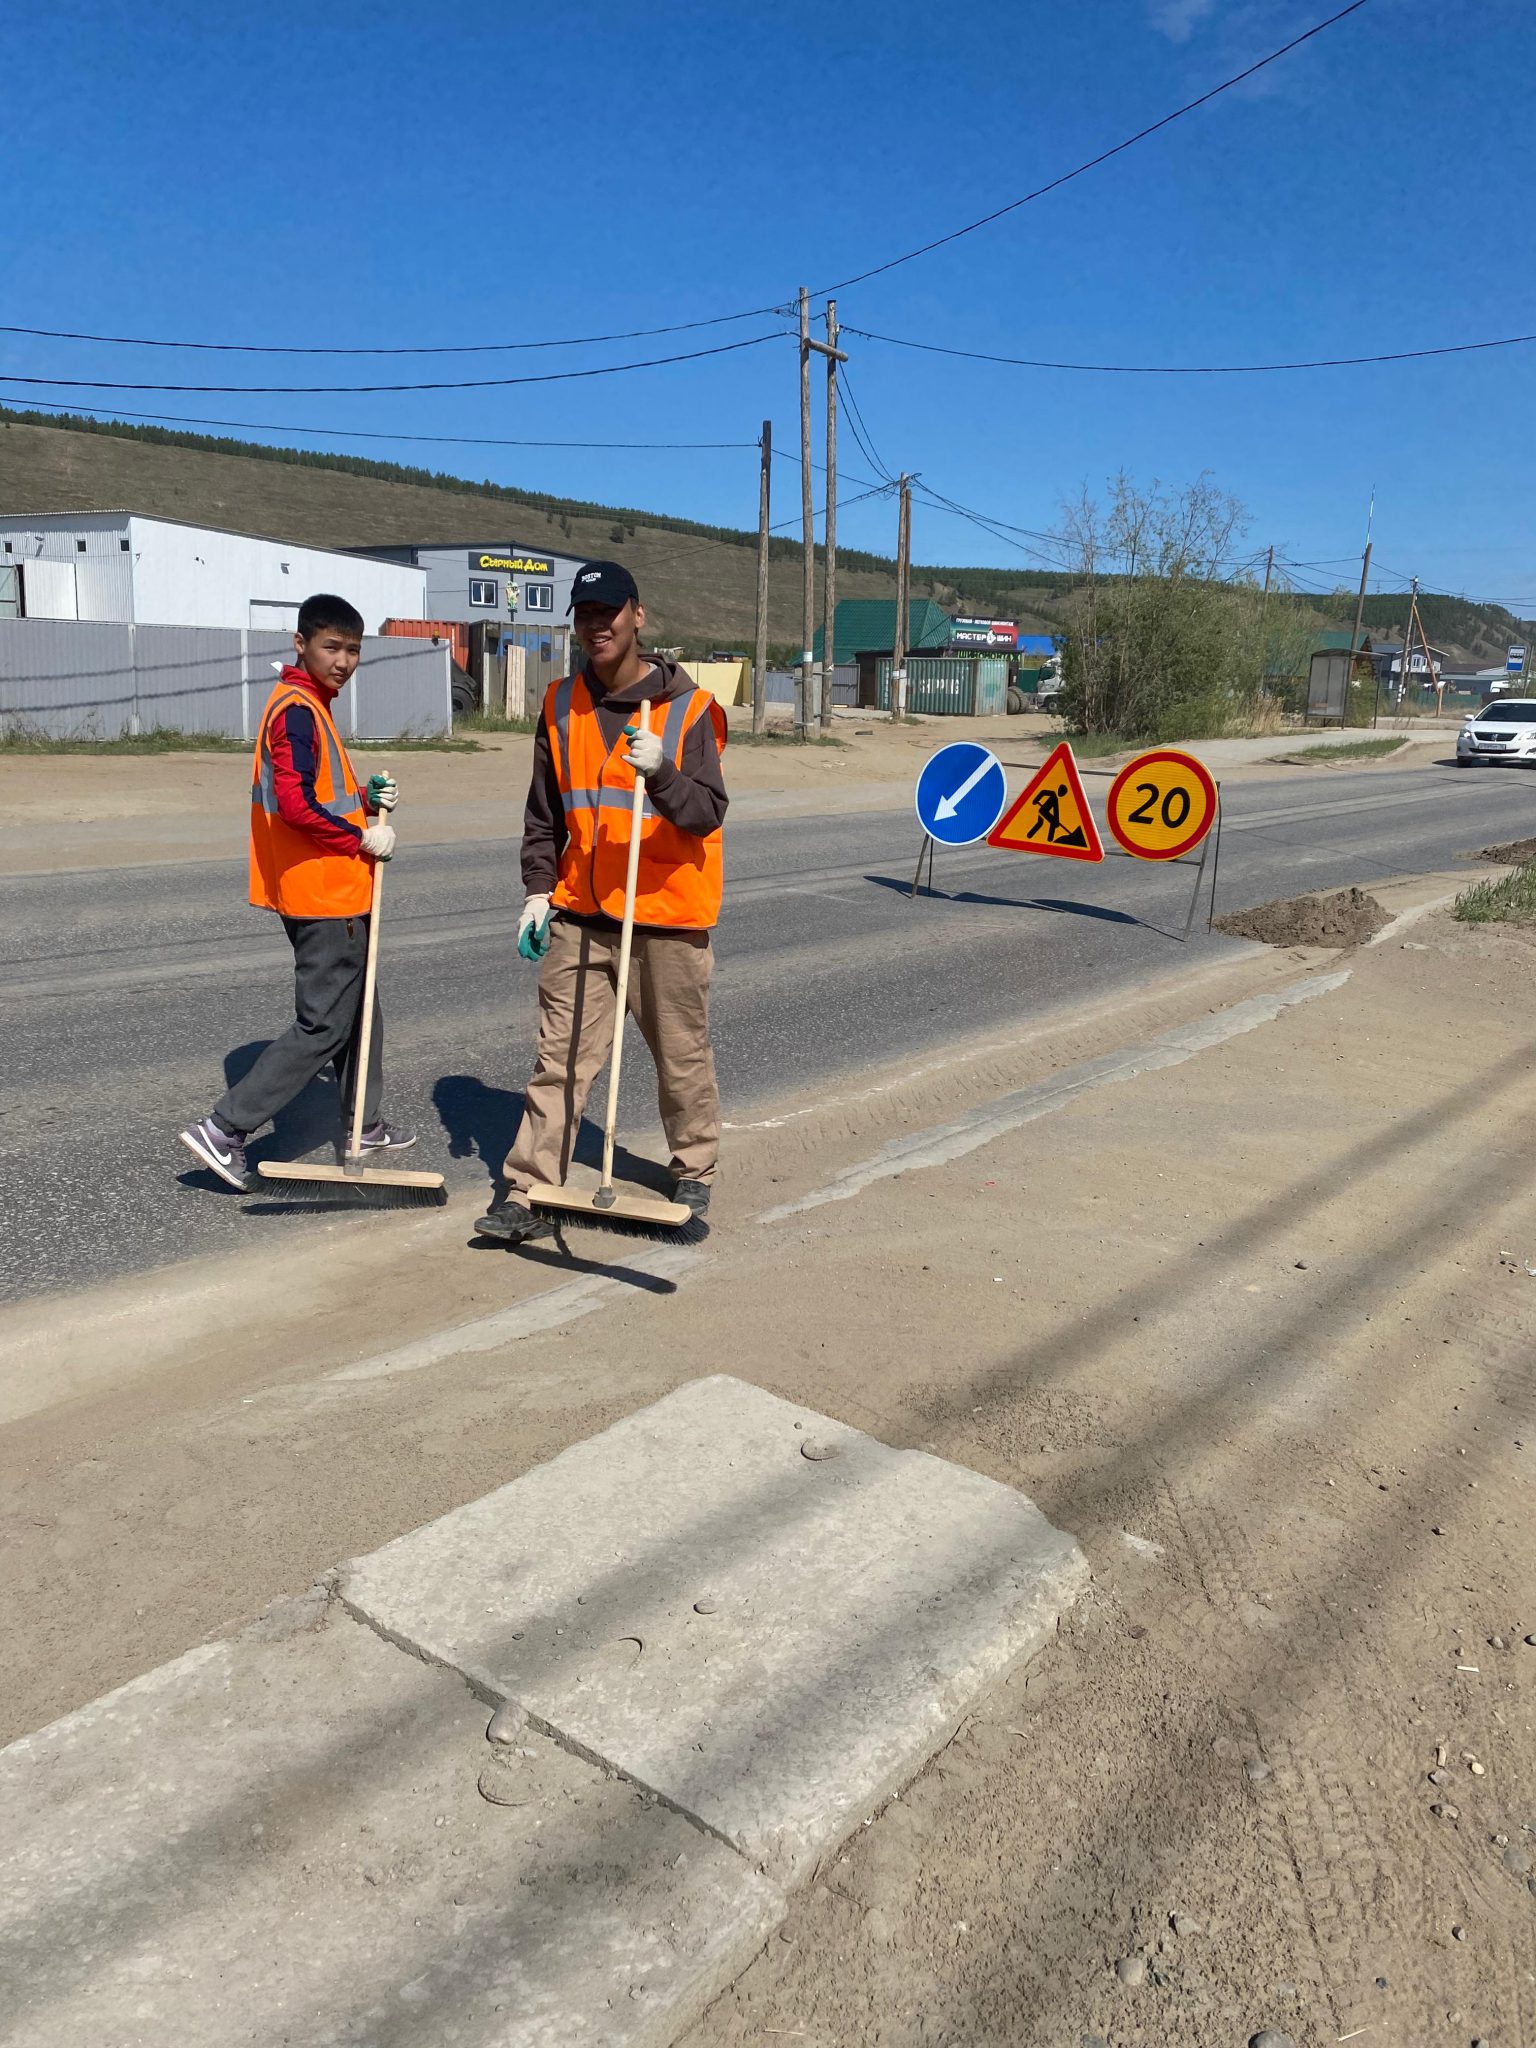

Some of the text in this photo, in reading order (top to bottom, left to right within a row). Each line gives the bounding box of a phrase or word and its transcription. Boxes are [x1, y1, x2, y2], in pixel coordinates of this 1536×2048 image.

[956, 632, 1012, 642] МАСТЕР ШИН
[1128, 783, 1191, 829] 20
